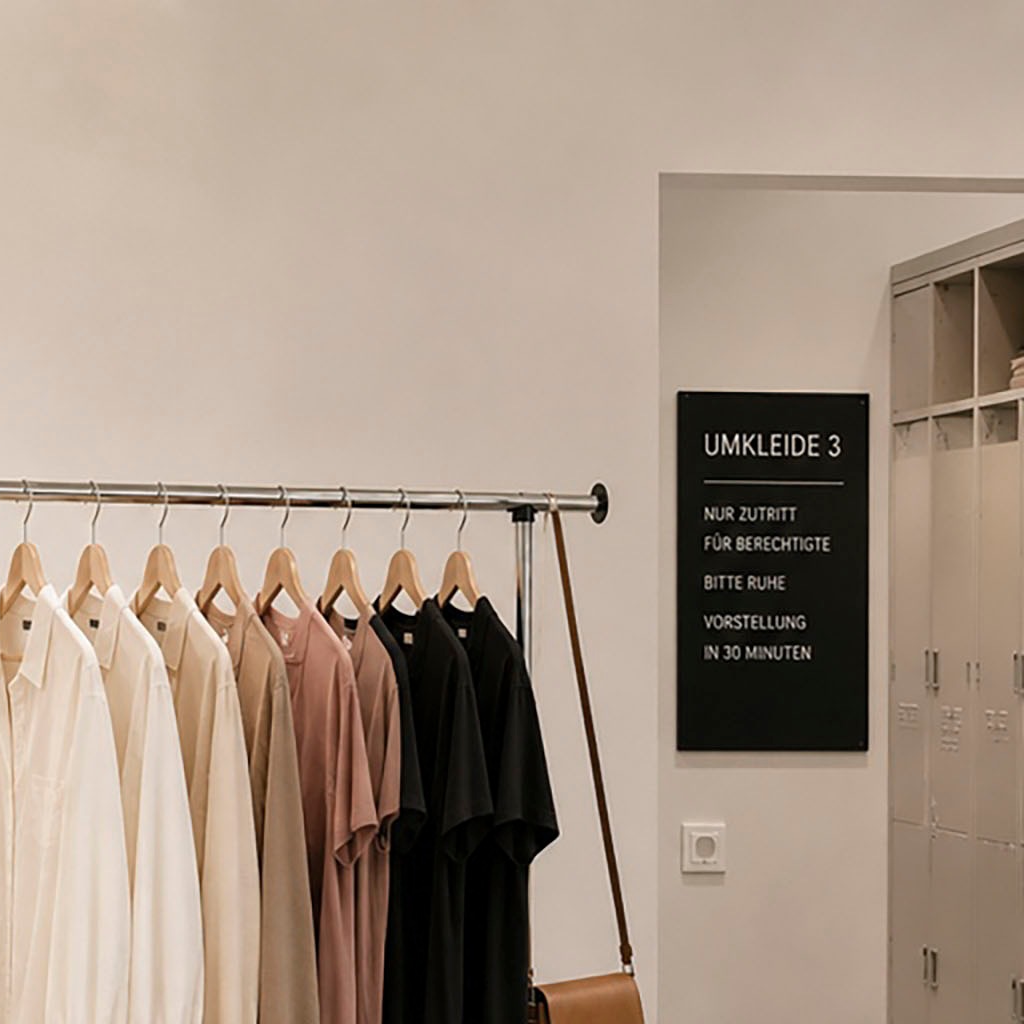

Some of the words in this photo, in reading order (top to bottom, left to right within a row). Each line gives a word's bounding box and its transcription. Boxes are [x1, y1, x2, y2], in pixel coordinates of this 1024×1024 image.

[704, 433, 820, 457] UMKLEIDE
[828, 434, 842, 458] 3
[704, 506, 735, 521] NUR
[739, 506, 797, 521] ZUTRITT
[736, 536, 831, 552] BERECHTIGTE
[704, 575, 743, 590] BITTE
[747, 575, 786, 590] RUHE
[704, 614, 807, 630] VORSTELLUNG
[704, 645, 719, 660] IN
[723, 645, 741, 660] 30
[745, 645, 812, 660] MINUTEN
